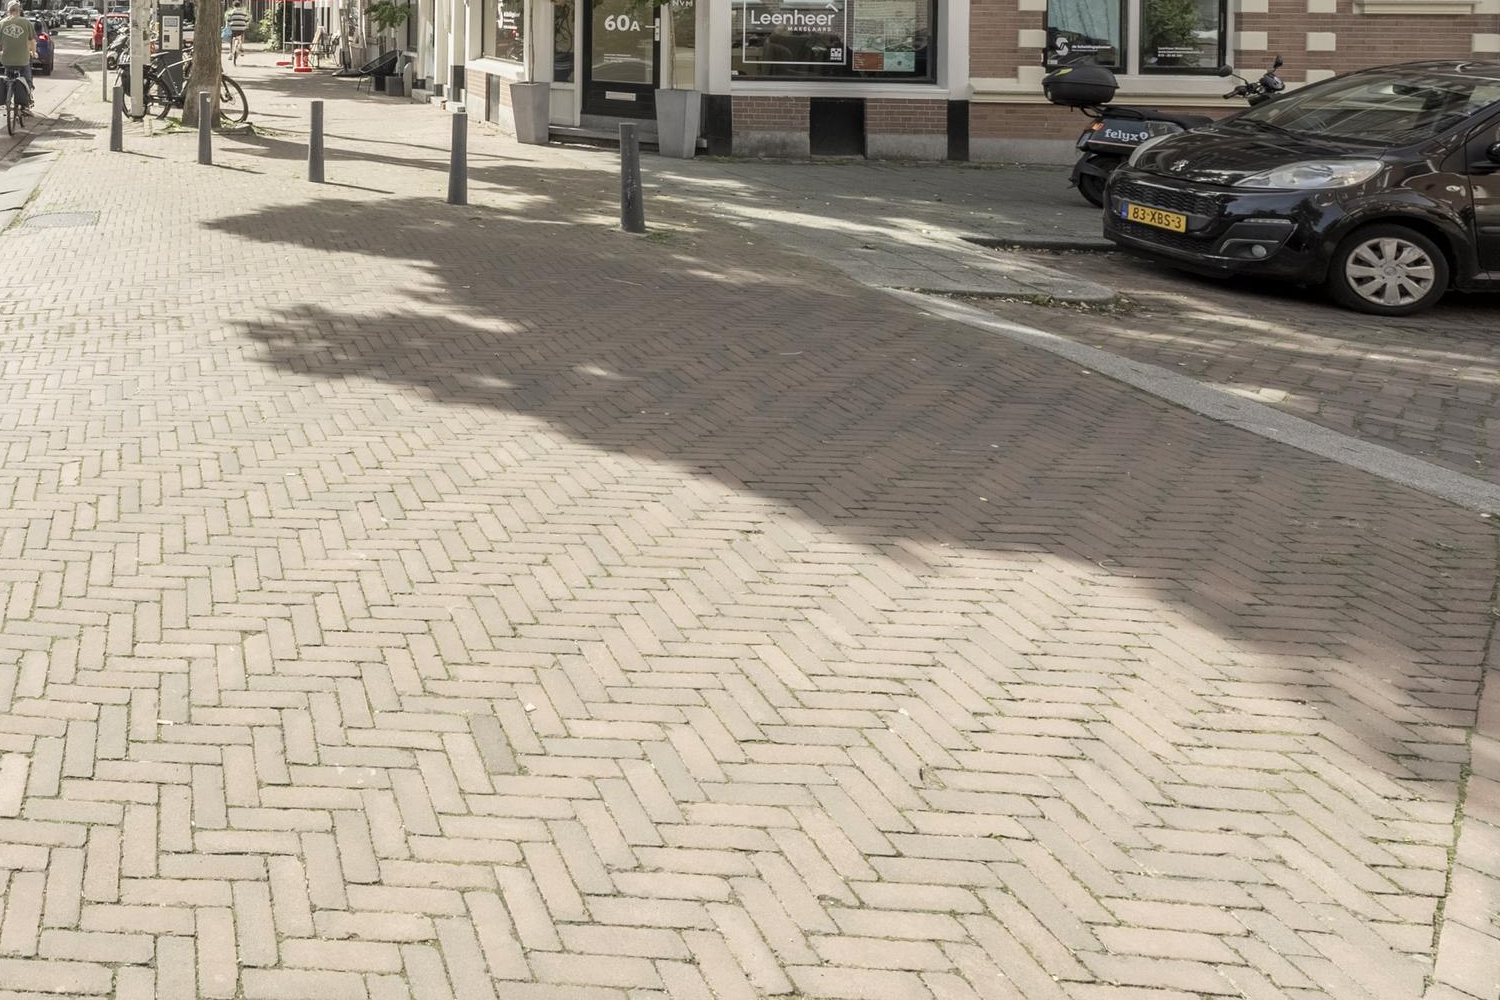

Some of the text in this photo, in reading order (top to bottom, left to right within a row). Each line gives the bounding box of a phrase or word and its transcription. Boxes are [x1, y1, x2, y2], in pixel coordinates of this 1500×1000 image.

[604, 14, 641, 31] 60A
[751, 10, 835, 25] Leenheer
[1105, 128, 1139, 141] felyx
[1132, 207, 1182, 229] 83-XBS-3
